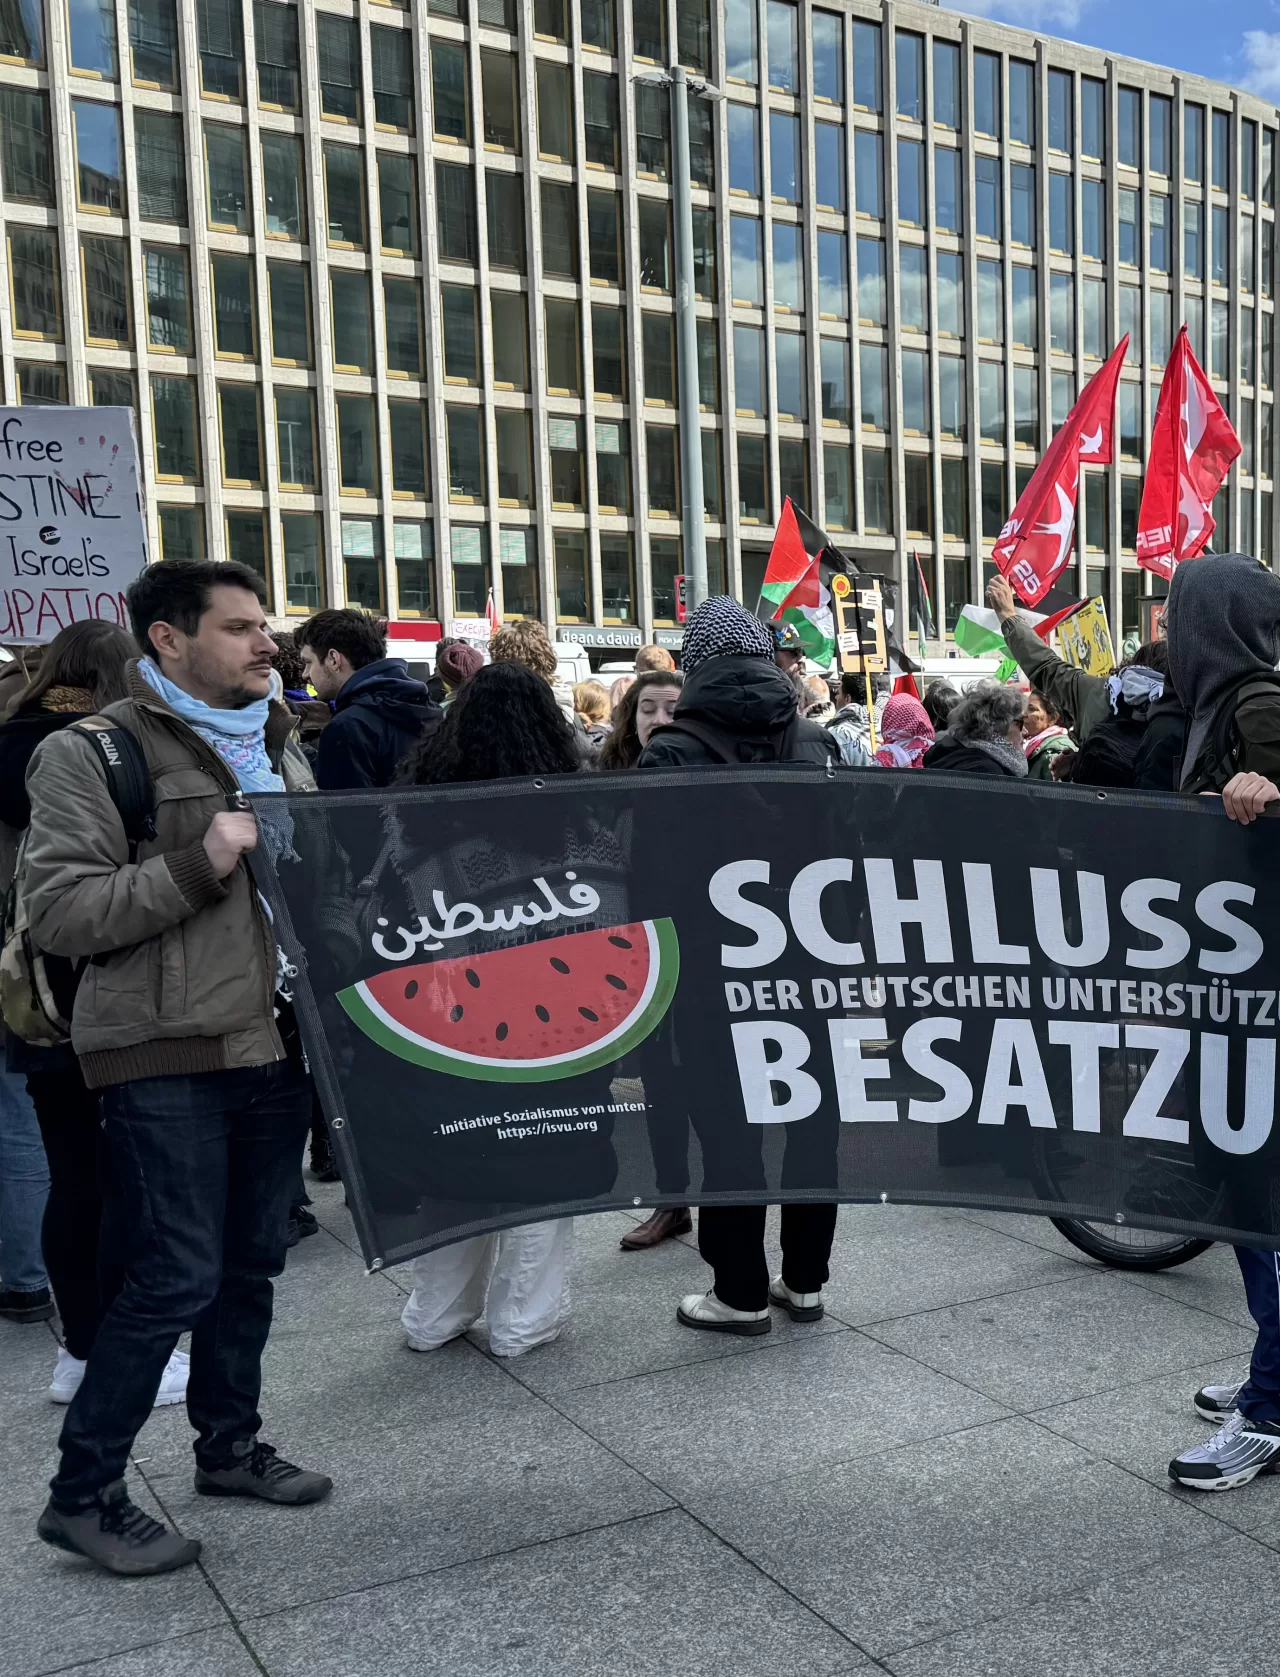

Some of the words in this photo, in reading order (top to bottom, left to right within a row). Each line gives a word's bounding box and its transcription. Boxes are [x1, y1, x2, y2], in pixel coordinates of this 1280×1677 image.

[6, 535, 110, 577] Israel's
[562, 631, 594, 645] dean
[596, 635, 605, 644] &
[606, 632, 642, 646] david
[371, 871, 600, 961] فلسطين
[708, 858, 1265, 975] SCHLUSS
[725, 979, 800, 1012] DER
[812, 976, 1032, 1011] DEUTSCHEN
[440, 1113, 502, 1136] Initiative
[504, 1105, 580, 1124] Sozialismus
[582, 1105, 605, 1116] von
[607, 1102, 646, 1114] unten
[497, 1119, 598, 1140] https://isvu.org
